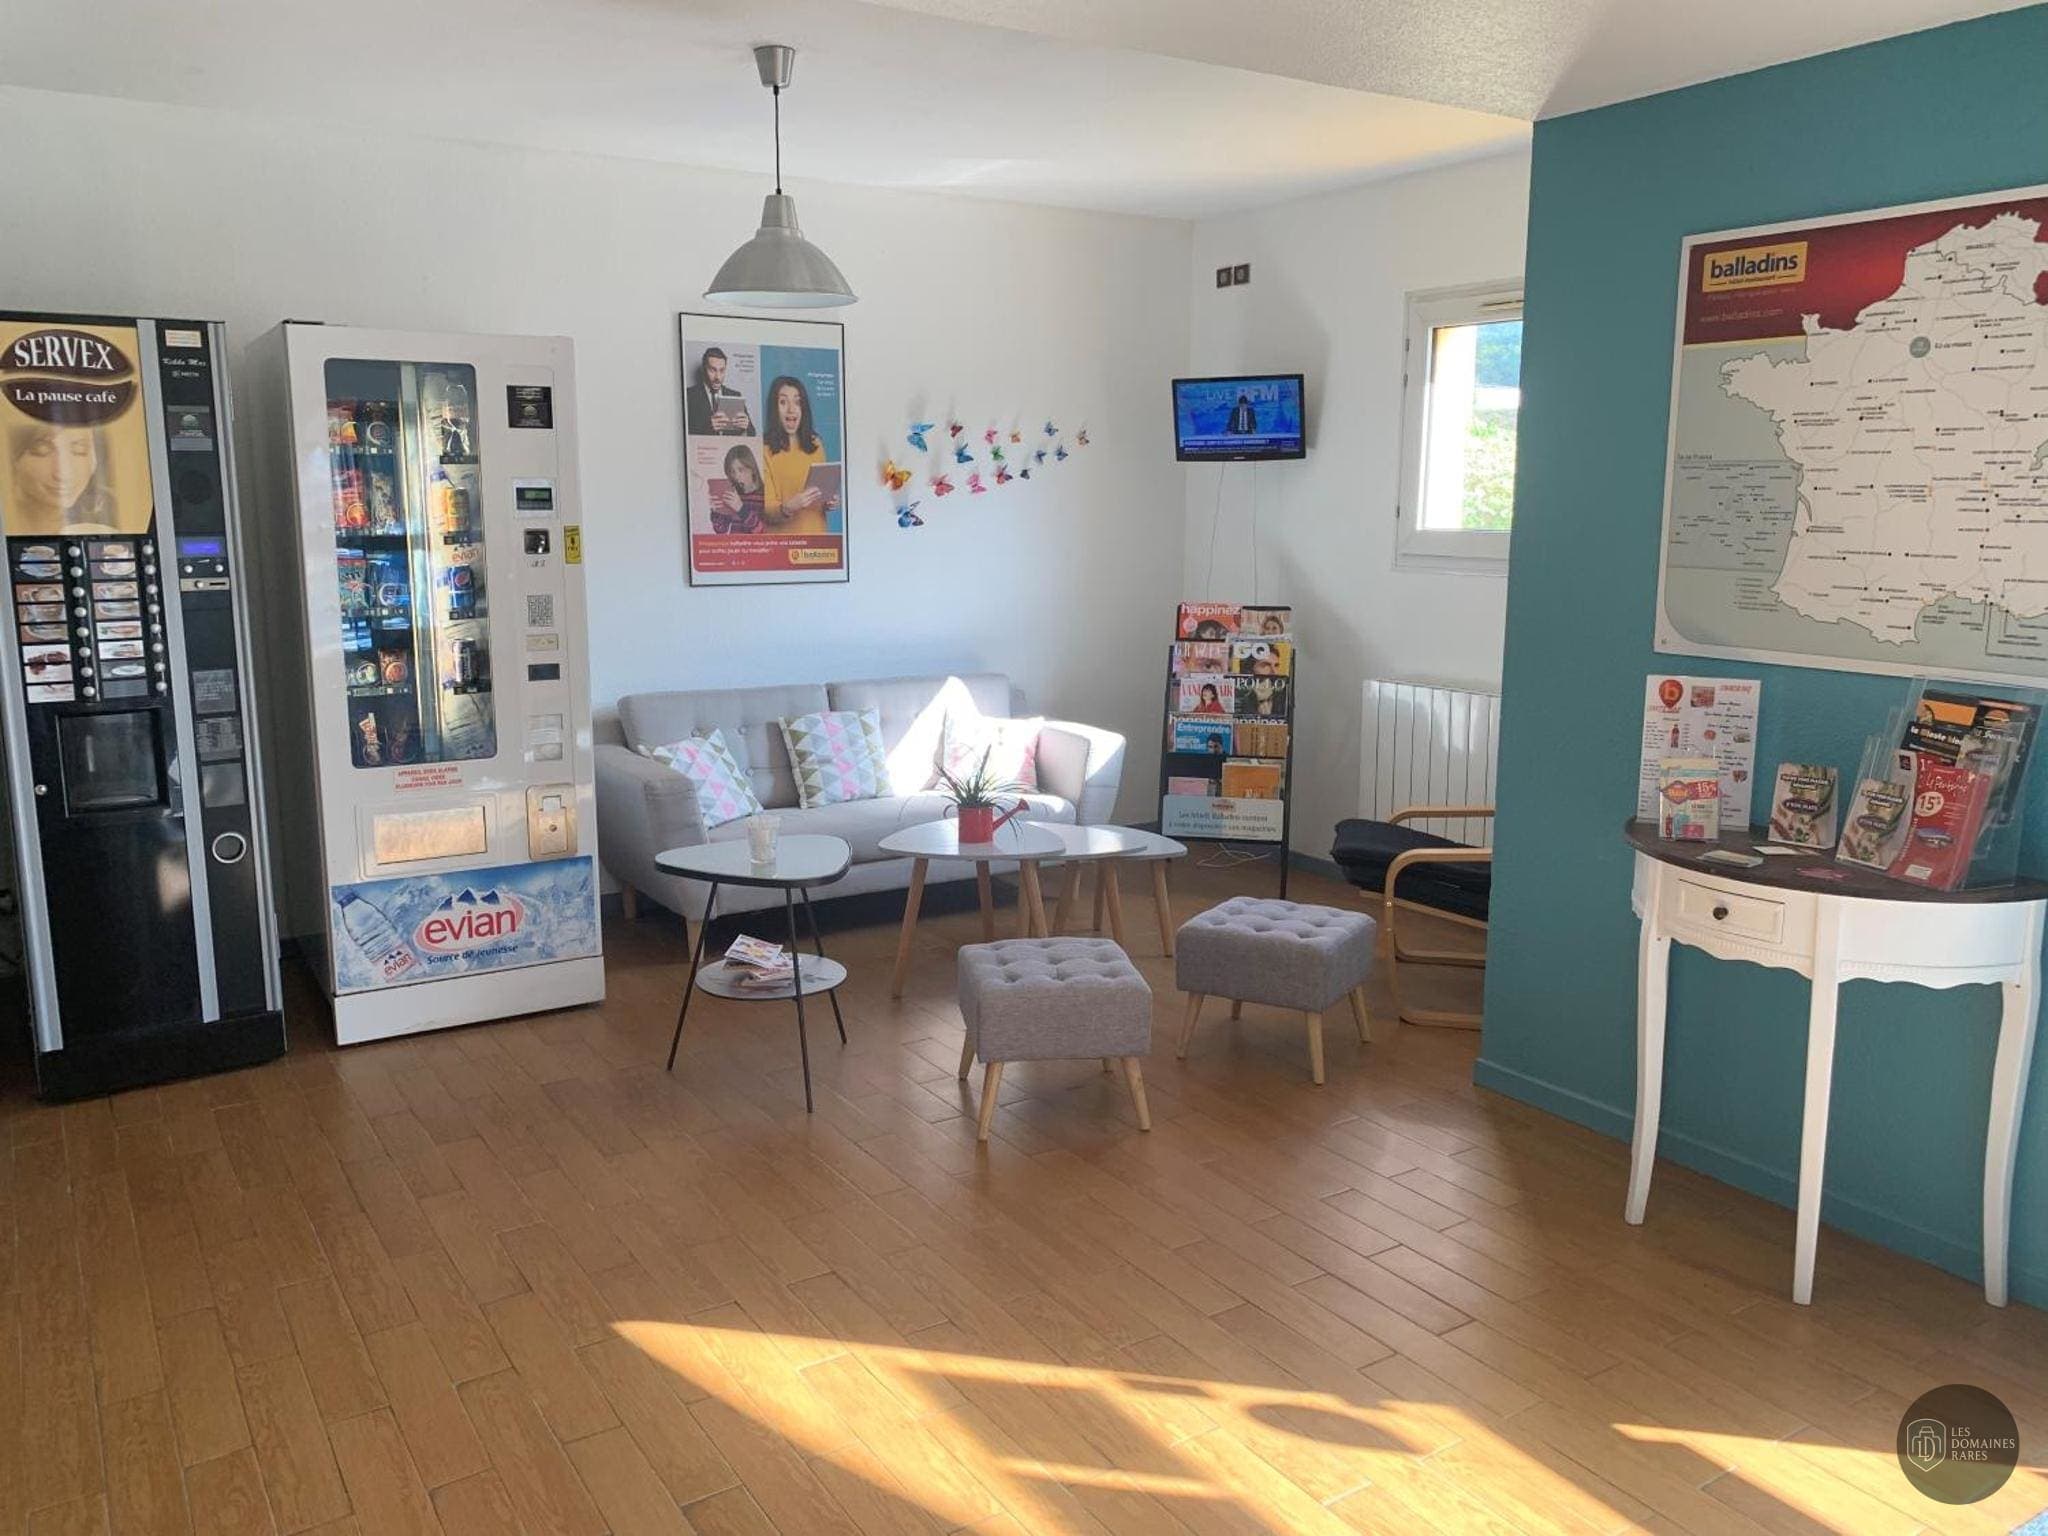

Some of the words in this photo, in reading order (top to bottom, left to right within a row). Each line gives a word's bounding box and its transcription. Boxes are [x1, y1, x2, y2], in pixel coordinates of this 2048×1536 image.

[1710, 253, 1798, 279] balladins
[14, 335, 114, 371] SERVEX
[15, 388, 34, 401] La
[38, 391, 82, 405] pause
[85, 390, 117, 403] café
[1234, 642, 1271, 660] GQ
[1177, 724, 1230, 733] Entreprendre
[424, 908, 516, 945] evian
[383, 952, 412, 977] evian
[427, 952, 460, 965] Source
[462, 949, 474, 961] de
